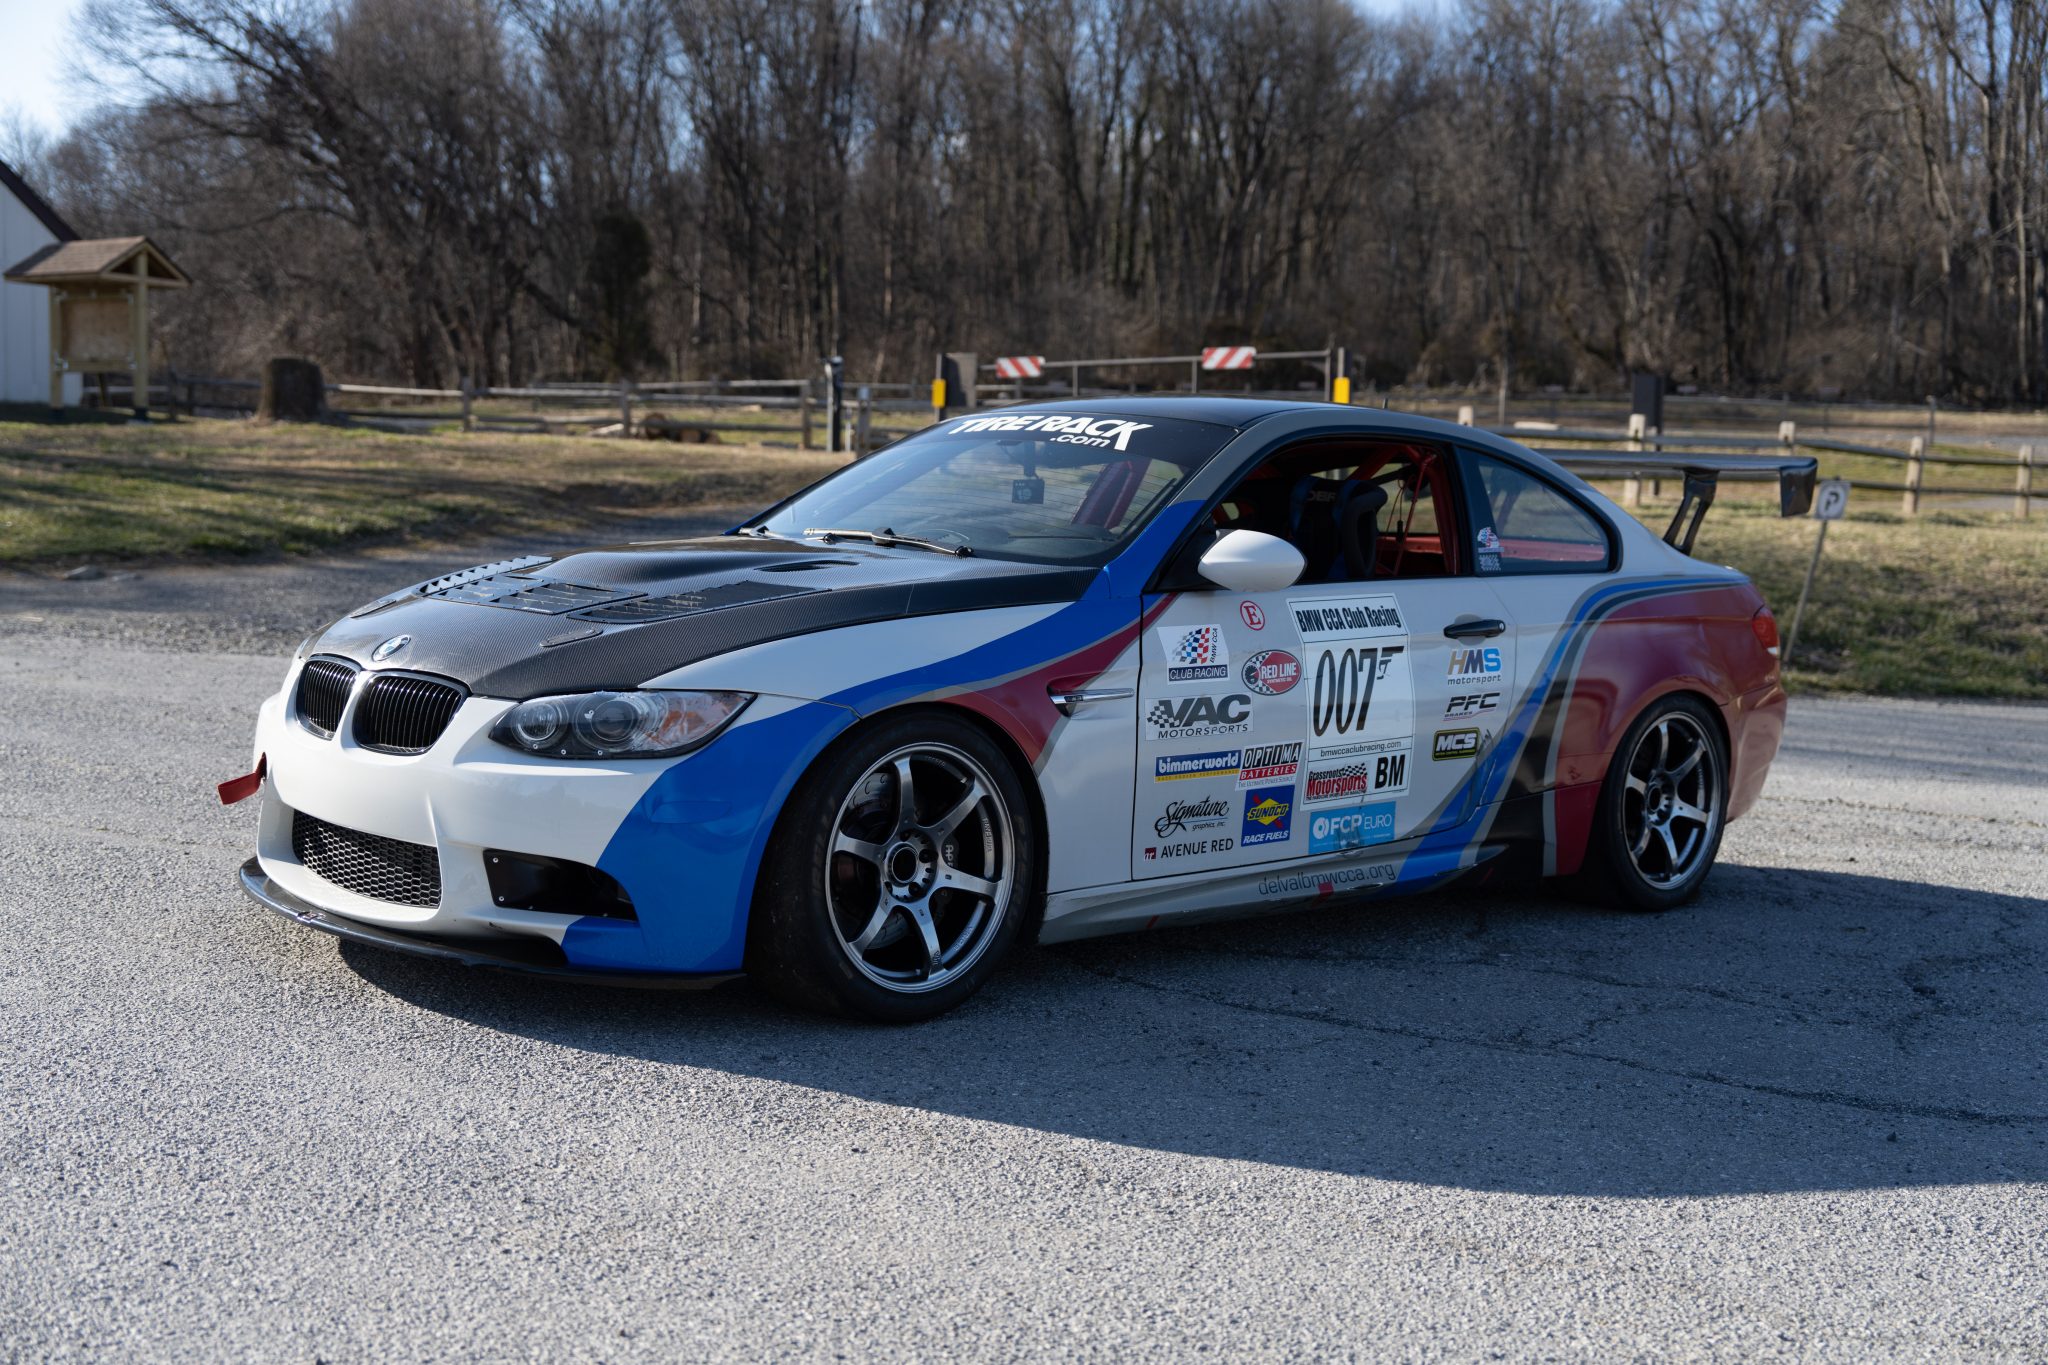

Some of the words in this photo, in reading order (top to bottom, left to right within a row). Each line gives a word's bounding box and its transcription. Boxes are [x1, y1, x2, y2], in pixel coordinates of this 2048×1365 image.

[1050, 433, 1110, 447] .com
[1825, 491, 1840, 510] P
[1243, 605, 1261, 626] E
[1296, 610, 1325, 632] BMW
[1322, 607, 1346, 631] CCA
[1342, 606, 1367, 629] Club
[1364, 605, 1402, 628] Racing
[1261, 664, 1278, 679] RED
[1279, 662, 1297, 677] LINE
[1447, 648, 1501, 675] HMS
[1169, 668, 1193, 680] CLUB
[1194, 666, 1226, 679] RACING
[1447, 674, 1501, 685] motorsport
[1313, 648, 1378, 737] 007
[1446, 692, 1500, 712] PFC
[1158, 694, 1251, 728] VAC
[1158, 723, 1248, 739] MOTORSPORTS
[1320, 741, 1402, 758] bmwccaclubracing.com
[1435, 733, 1477, 752] MCS
[1158, 753, 1239, 773] bimmerworld
[1243, 743, 1301, 768] OPTIMA
[1241, 765, 1297, 779] BATTERIES
[1309, 768, 1343, 780] Grassroots
[1375, 754, 1405, 789] BM
[1307, 775, 1367, 796] Motorsports
[1155, 794, 1229, 838] Signature
[1249, 804, 1287, 819] SUNOCO
[1330, 814, 1362, 835] FCP
[1364, 813, 1392, 830] EURO
[1243, 833, 1265, 844] RACE
[1265, 830, 1289, 842] FUELS
[1161, 841, 1207, 858] AVENUE
[1211, 838, 1234, 852] RED
[1258, 864, 1396, 895] delvalbmwcca.org
